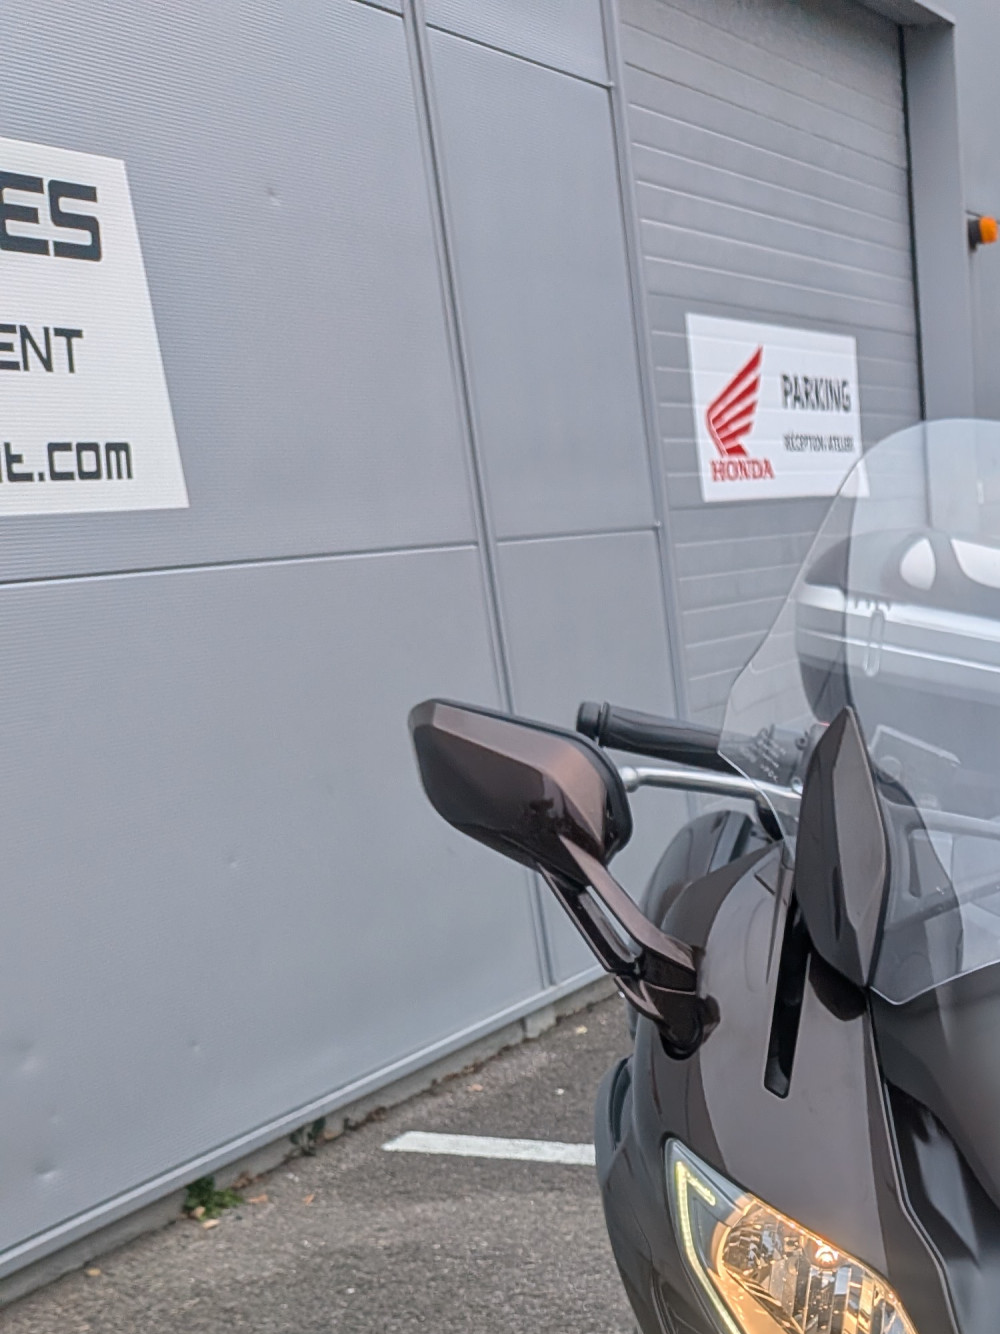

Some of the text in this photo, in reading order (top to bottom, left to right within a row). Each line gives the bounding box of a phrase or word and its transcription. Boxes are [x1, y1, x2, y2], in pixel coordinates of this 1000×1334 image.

[781, 374, 851, 412] PARKING
[0, 441, 133, 484] t.com
[710, 458, 775, 483] HONDA
